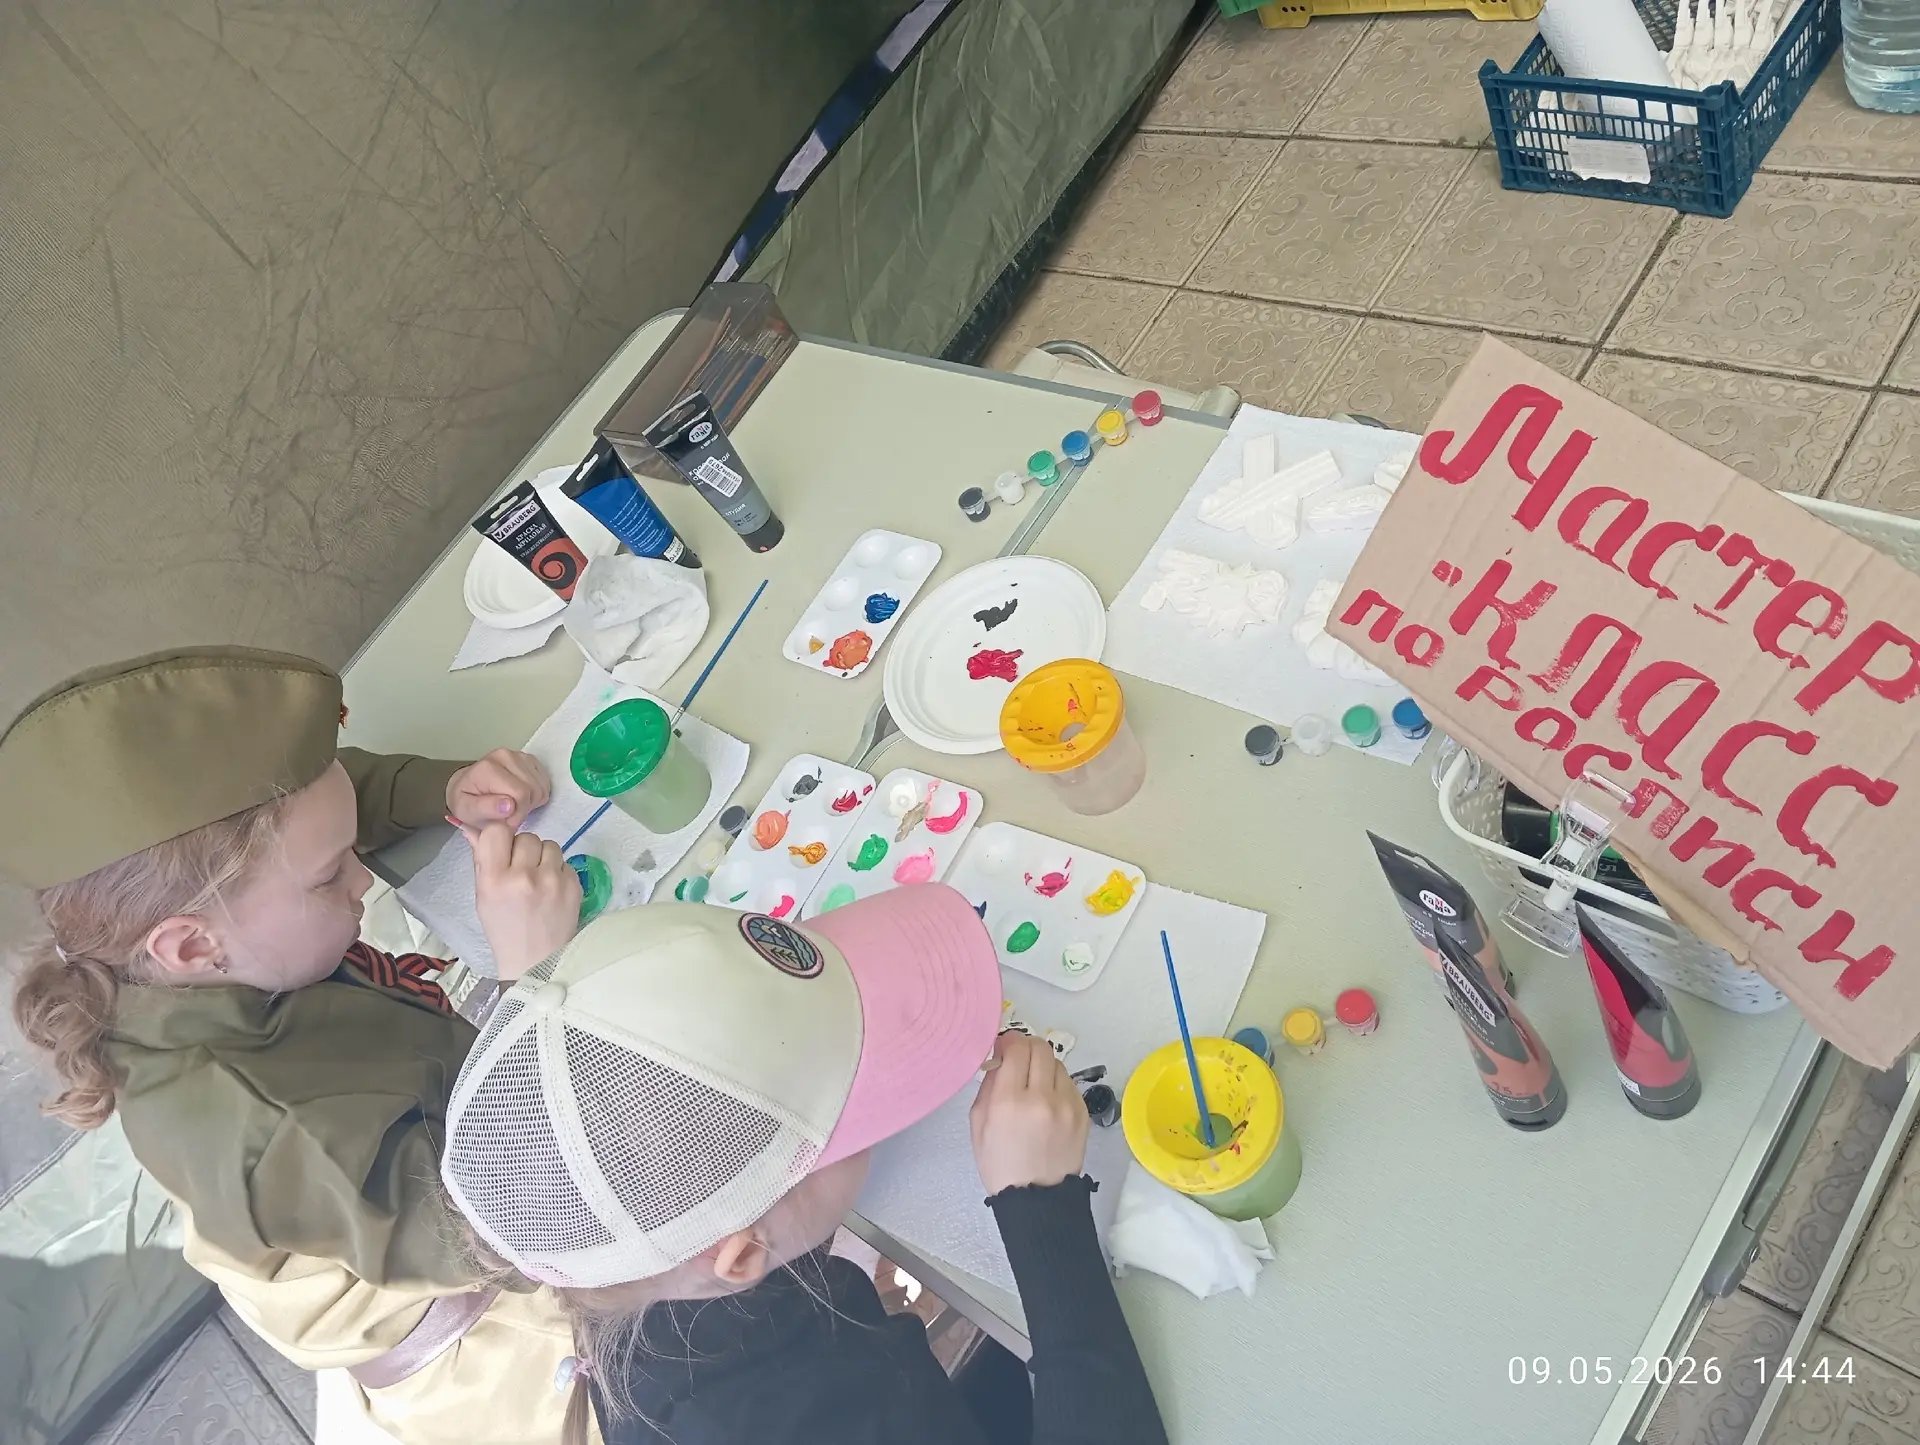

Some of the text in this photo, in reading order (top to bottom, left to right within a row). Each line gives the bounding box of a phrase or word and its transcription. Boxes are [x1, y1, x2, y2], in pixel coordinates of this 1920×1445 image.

[503, 504, 536, 534] BRAUBERG
[515, 523, 538, 541] КРАСКА
[1447, 968, 1491, 1021] BRAUBERG
